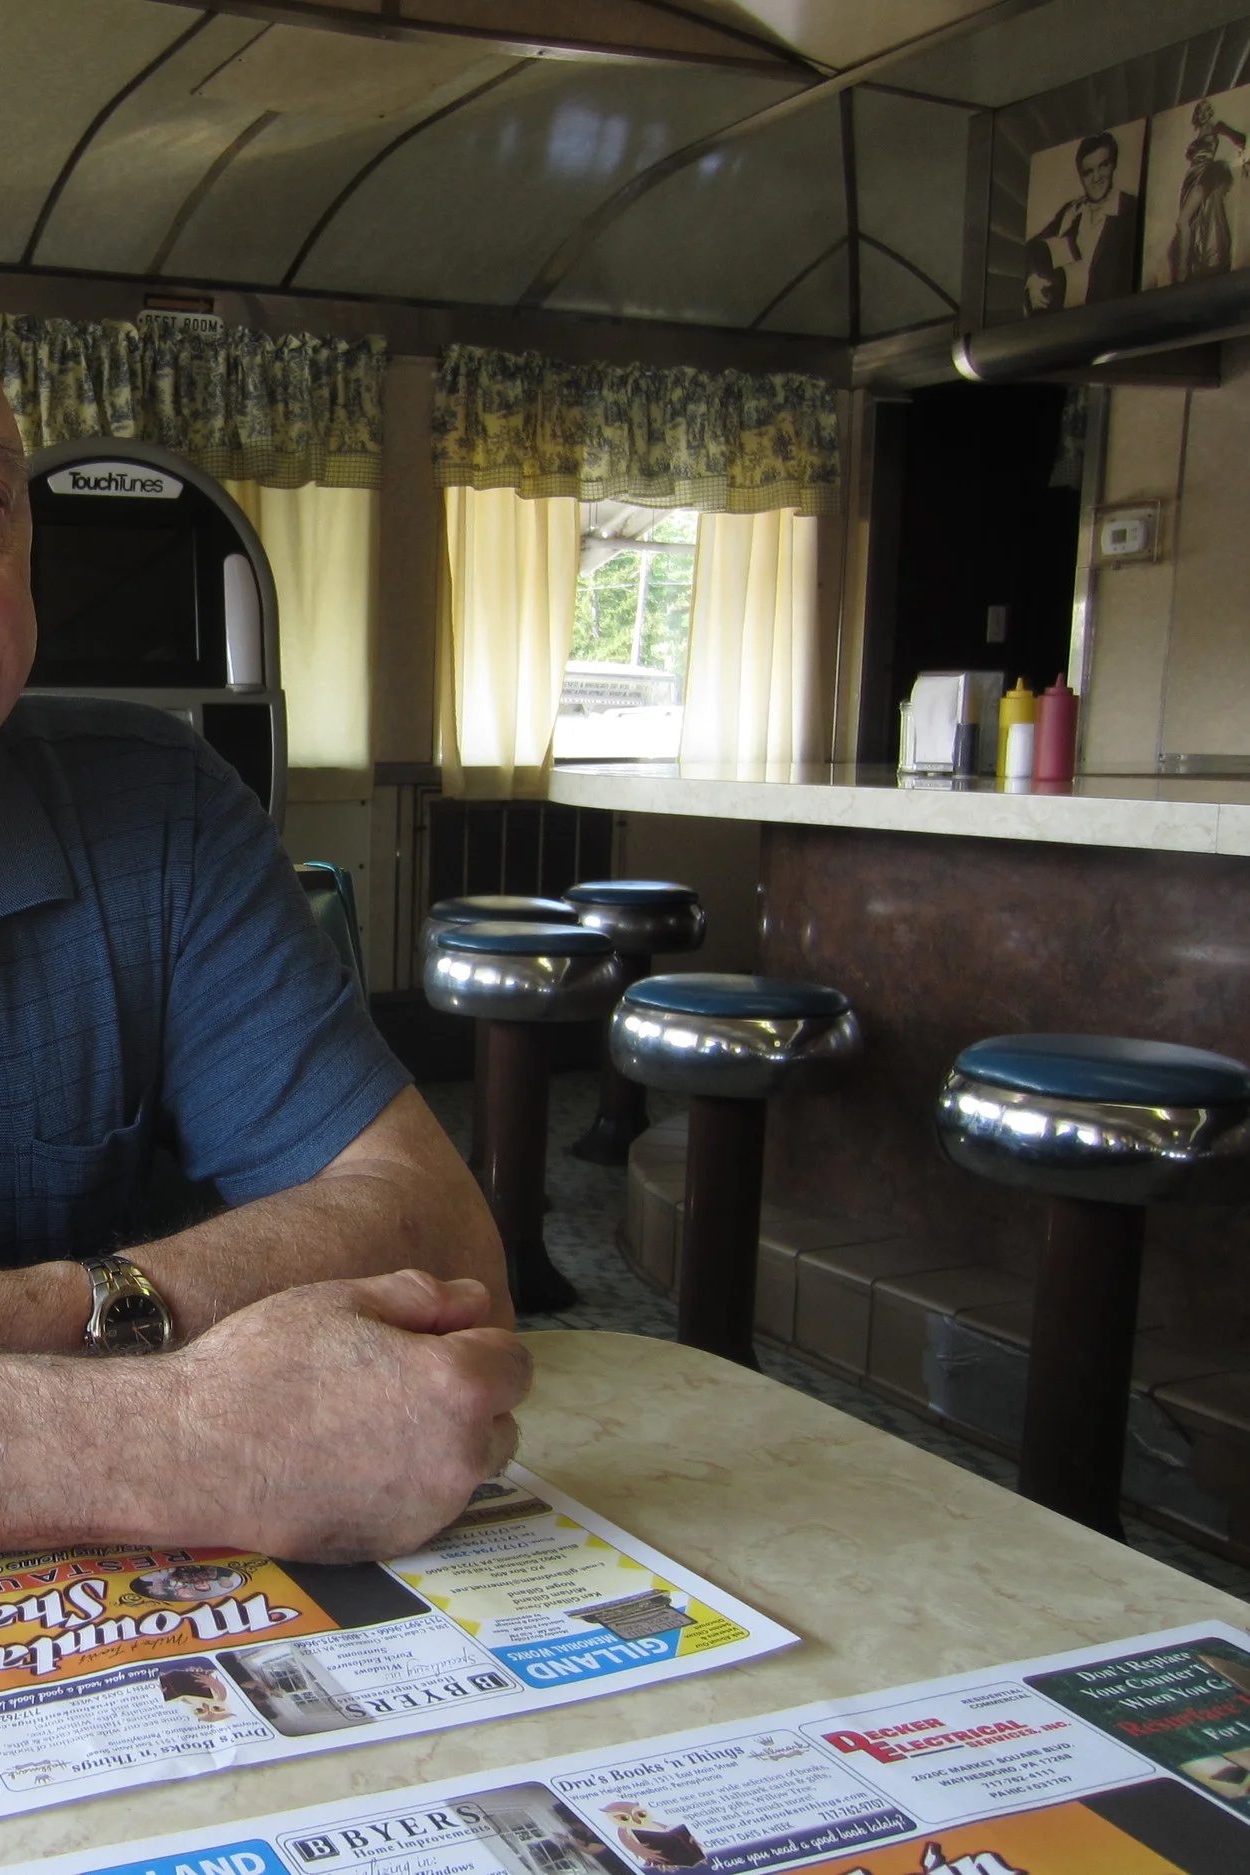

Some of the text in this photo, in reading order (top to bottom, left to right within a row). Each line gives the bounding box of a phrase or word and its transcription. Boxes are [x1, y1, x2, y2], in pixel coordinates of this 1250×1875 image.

[184, 317, 217, 333] ROOM
[69, 471, 163, 493] TouchTunes
[531, 1545, 558, 1556] Ridge
[559, 1543, 579, 1551] Blue
[8, 1552, 67, 1572] Home
[493, 1558, 537, 1571] Buchanan
[509, 1566, 527, 1575] Box
[506, 1579, 575, 1597] Roger Gilland
[512, 1586, 586, 1605] Miriam Gilland
[581, 1589, 602, 1600] Ken
[514, 1602, 541, 1611] Owner
[551, 1633, 618, 1652] MEMORIAL
[325, 1650, 413, 1672] Porch Enclosures
[337, 1647, 387, 1660] Sunrooms
[405, 1647, 476, 1677] Specializing
[506, 1646, 550, 1662] WORKS
[526, 1637, 669, 1680] GILLAND
[127, 1666, 159, 1681] Have
[352, 1663, 402, 1676] Windows
[1079, 1665, 1129, 1682] Don't
[1126, 1651, 1191, 1671] Replace
[76, 1680, 102, 1695] read
[104, 1672, 125, 1685] you
[133, 1682, 157, 1691] OPEN
[1080, 1683, 1126, 1699] Your
[1125, 1665, 1195, 1689] Counter
[38, 1685, 64, 1700] good
[102, 1689, 123, 1700] DAYS
[335, 1675, 456, 1705] Home Improvements
[344, 1681, 468, 1718] BYERS
[961, 1688, 1021, 1704] RESIDENTIAL
[1119, 1686, 1210, 1709] When You
[8, 1694, 36, 1707] book
[968, 1693, 1031, 1710] COMMERCIAL
[1118, 1704, 1235, 1737] Resurface
[219, 1726, 268, 1744] Dru's
[821, 1718, 946, 1753] DECKER
[862, 1720, 1028, 1764] ELECTRICAL
[965, 1721, 1072, 1747] SERVICES, INC.
[1203, 1727, 1241, 1740] For
[160, 1738, 214, 1755] Books
[72, 1753, 136, 1774] Things
[558, 1746, 746, 1792] Dru's Books Things
[912, 1743, 1075, 1781] 2020C MARKET SQUARE BLVD.
[1040, 1754, 1072, 1765] 17268
[982, 1768, 1056, 1789] 717-762-4111
[648, 1773, 784, 1809] Come wide selection
[818, 1798, 885, 1821] 717-762-9707
[339, 1805, 481, 1849] BYERS
[353, 1824, 491, 1858] Home Improvements
[703, 1836, 730, 1849] OPEN
[737, 1828, 762, 1841] DAYS
[711, 1814, 904, 1870] Have you read good book lately?
